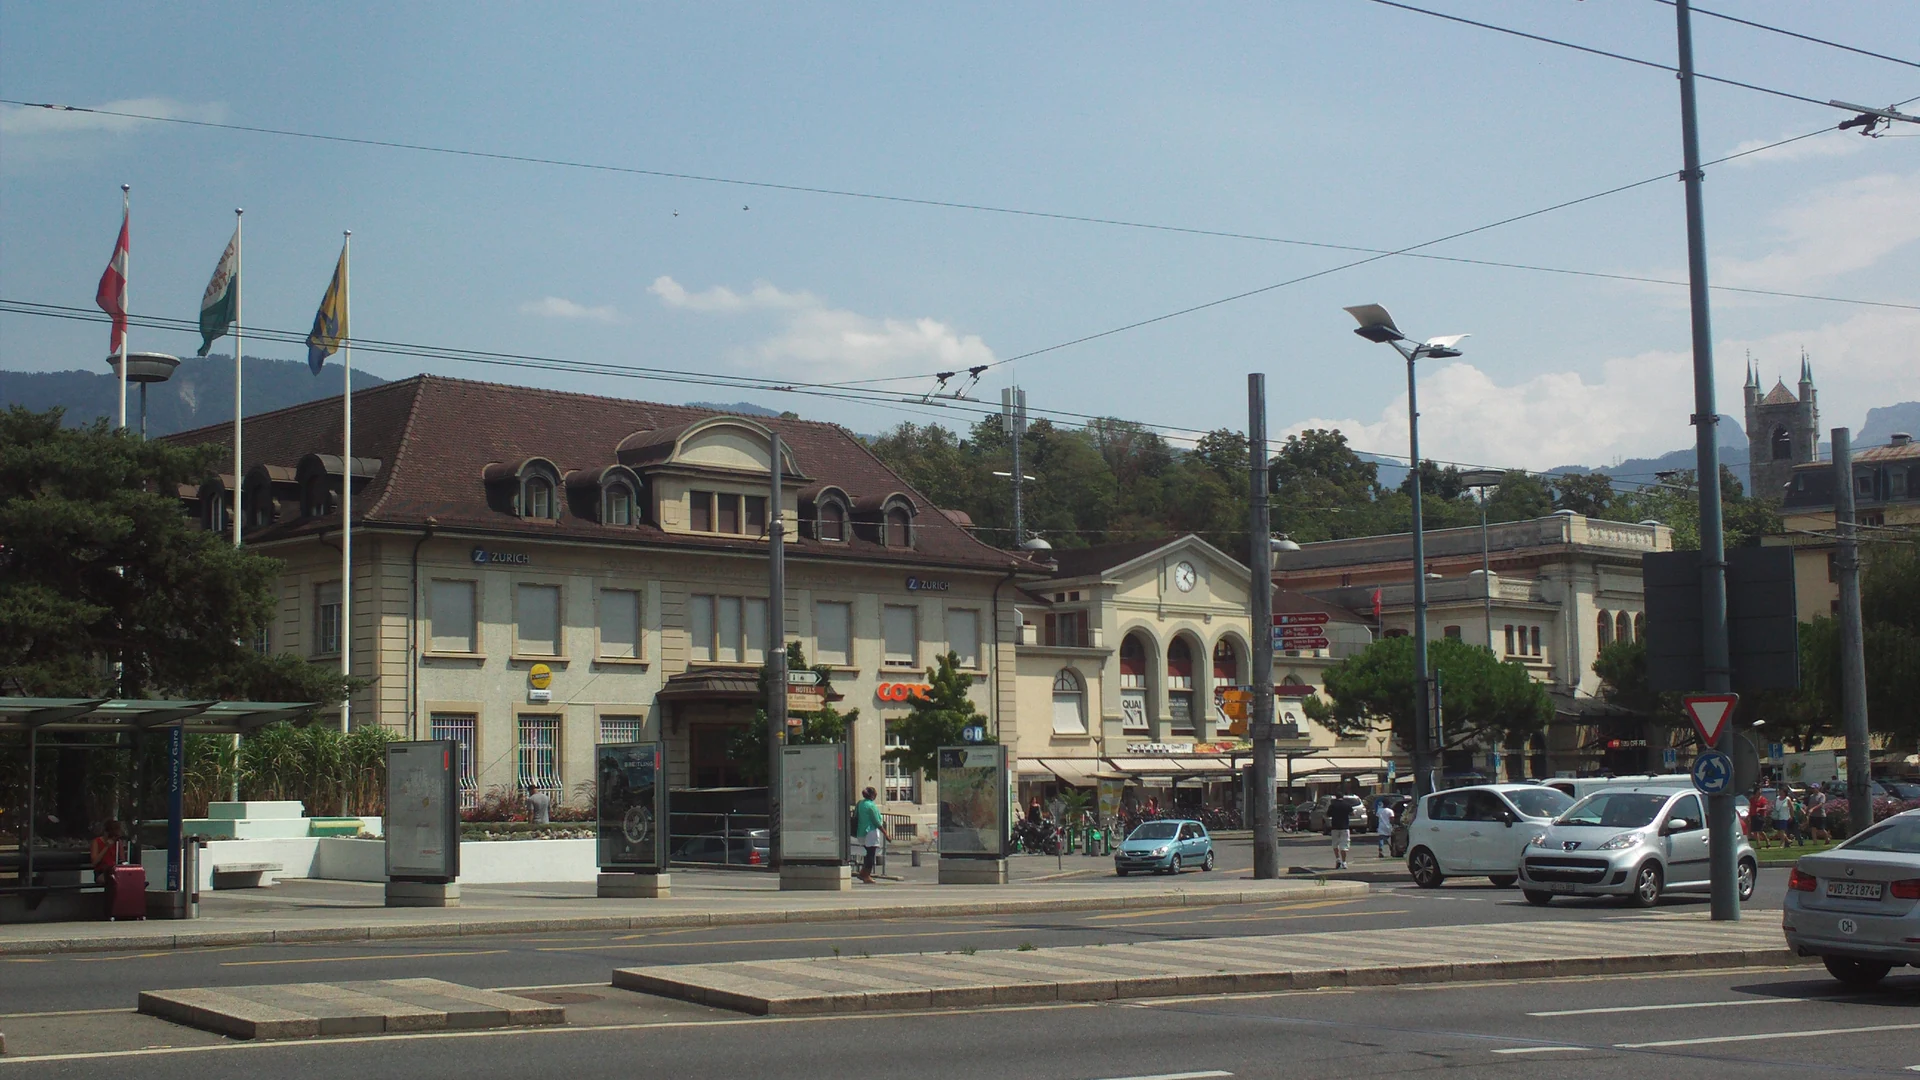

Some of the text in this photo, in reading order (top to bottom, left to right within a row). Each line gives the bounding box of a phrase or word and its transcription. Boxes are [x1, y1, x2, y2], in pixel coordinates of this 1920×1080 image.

[492, 552, 530, 563] ZURICH
[922, 581, 950, 590] ZURICH
[1122, 699, 1142, 709] QUAI
[624, 760, 654, 768] BREITLING
[1842, 920, 1853, 932] CH
